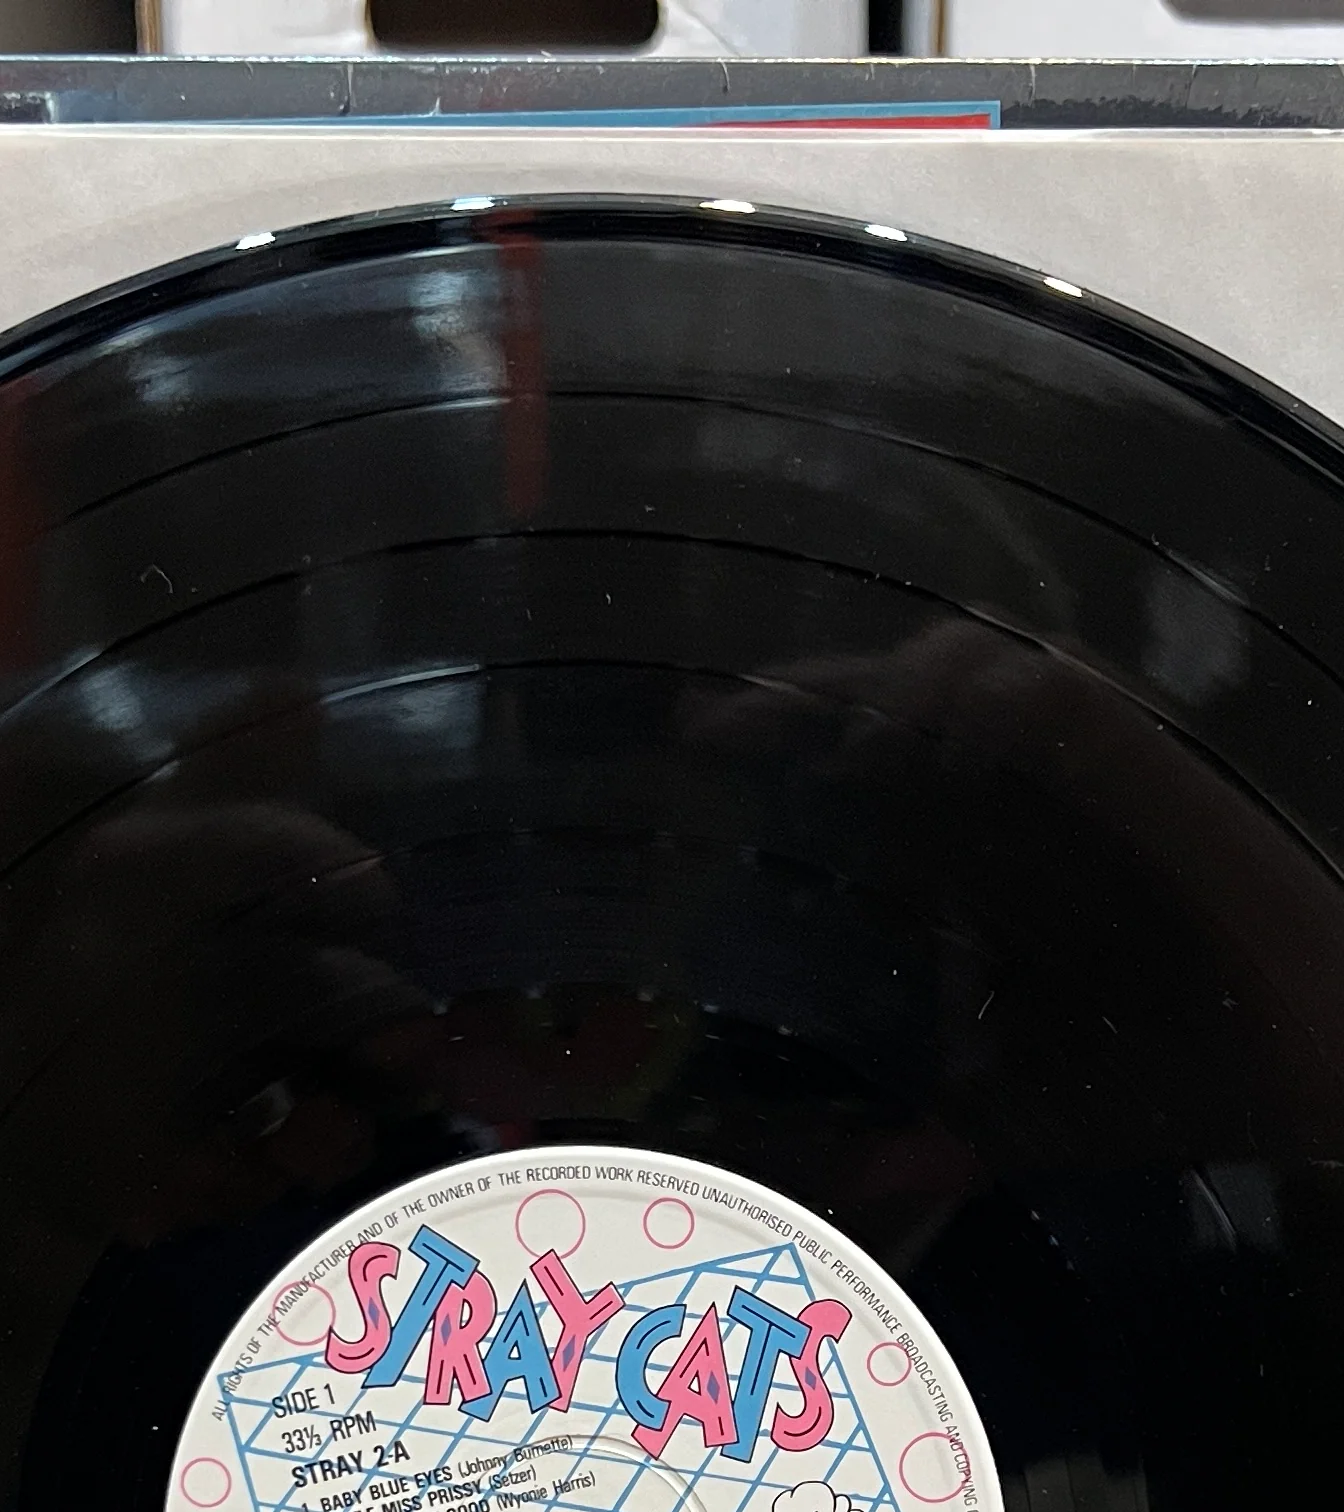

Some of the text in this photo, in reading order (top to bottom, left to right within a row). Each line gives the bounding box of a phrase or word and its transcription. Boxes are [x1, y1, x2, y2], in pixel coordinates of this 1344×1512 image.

[478, 1176, 492, 1192] OF
[498, 1170, 521, 1187] THE
[526, 1165, 591, 1182] RECORDED
[595, 1166, 633, 1182] WORK
[637, 1170, 700, 1196] RESERVED
[427, 1181, 475, 1208] OWNER
[384, 1211, 399, 1229] OF
[402, 1198, 427, 1219] THE
[702, 1185, 793, 1237] UNAUTHORISED
[358, 1222, 383, 1244] AND
[792, 1230, 833, 1264] PUBLIC
[275, 1240, 356, 1316] MANUFACTURER
[830, 1259, 902, 1335] PERFORMANCE
[257, 1313, 281, 1336] THE
[246, 1337, 262, 1355] OF
[325, 1225, 852, 1463] STRAY CATS
[223, 1353, 253, 1394] RIGHTS
[896, 1333, 954, 1422] BROADCASTING
[212, 1400, 230, 1421] ALL
[272, 1383, 335, 1418] SIDE 1
[330, 1410, 377, 1442] RPM
[945, 1425, 964, 1451] AND
[291, 1440, 411, 1488] STRAY 2-A
[320, 1490, 362, 1512] BABY
[370, 1478, 410, 1501] BLUE
[414, 1465, 453, 1491] EYES
[458, 1454, 508, 1478] (Johnny
[428, 1479, 481, 1507] PRISSY
[489, 1464, 536, 1491] (Setzer)
[553, 1471, 596, 1496] Harris)
[954, 1453, 977, 1506] COPYING
